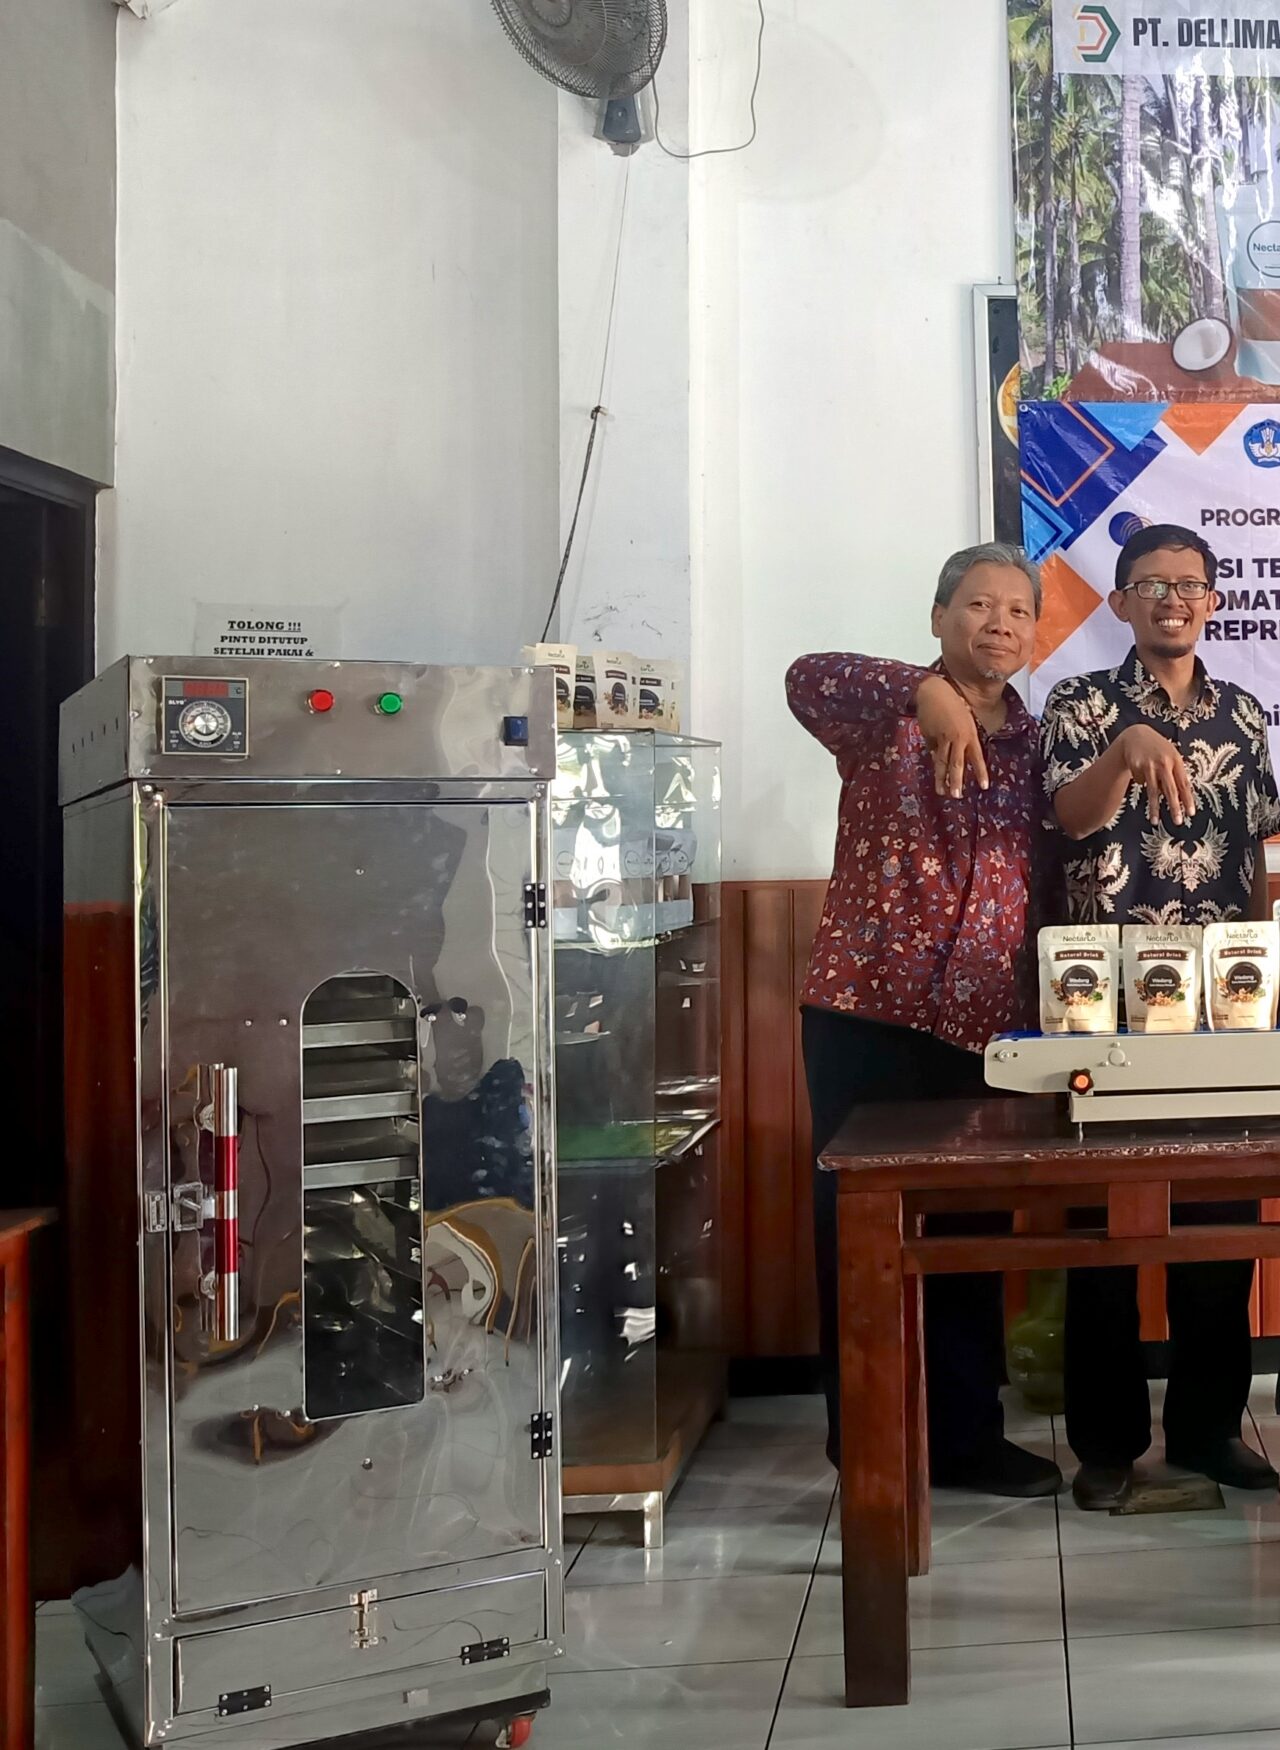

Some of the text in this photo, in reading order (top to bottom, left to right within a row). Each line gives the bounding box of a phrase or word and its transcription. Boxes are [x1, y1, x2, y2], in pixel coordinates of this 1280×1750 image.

[1132, 17, 1169, 47] PT.
[227, 620, 302, 632] TOLONG !!!
[220, 635, 309, 645] PINTU DITUTUP
[213, 647, 315, 657] SETELAH PAKAI &
[1062, 934, 1097, 943] NectarLo
